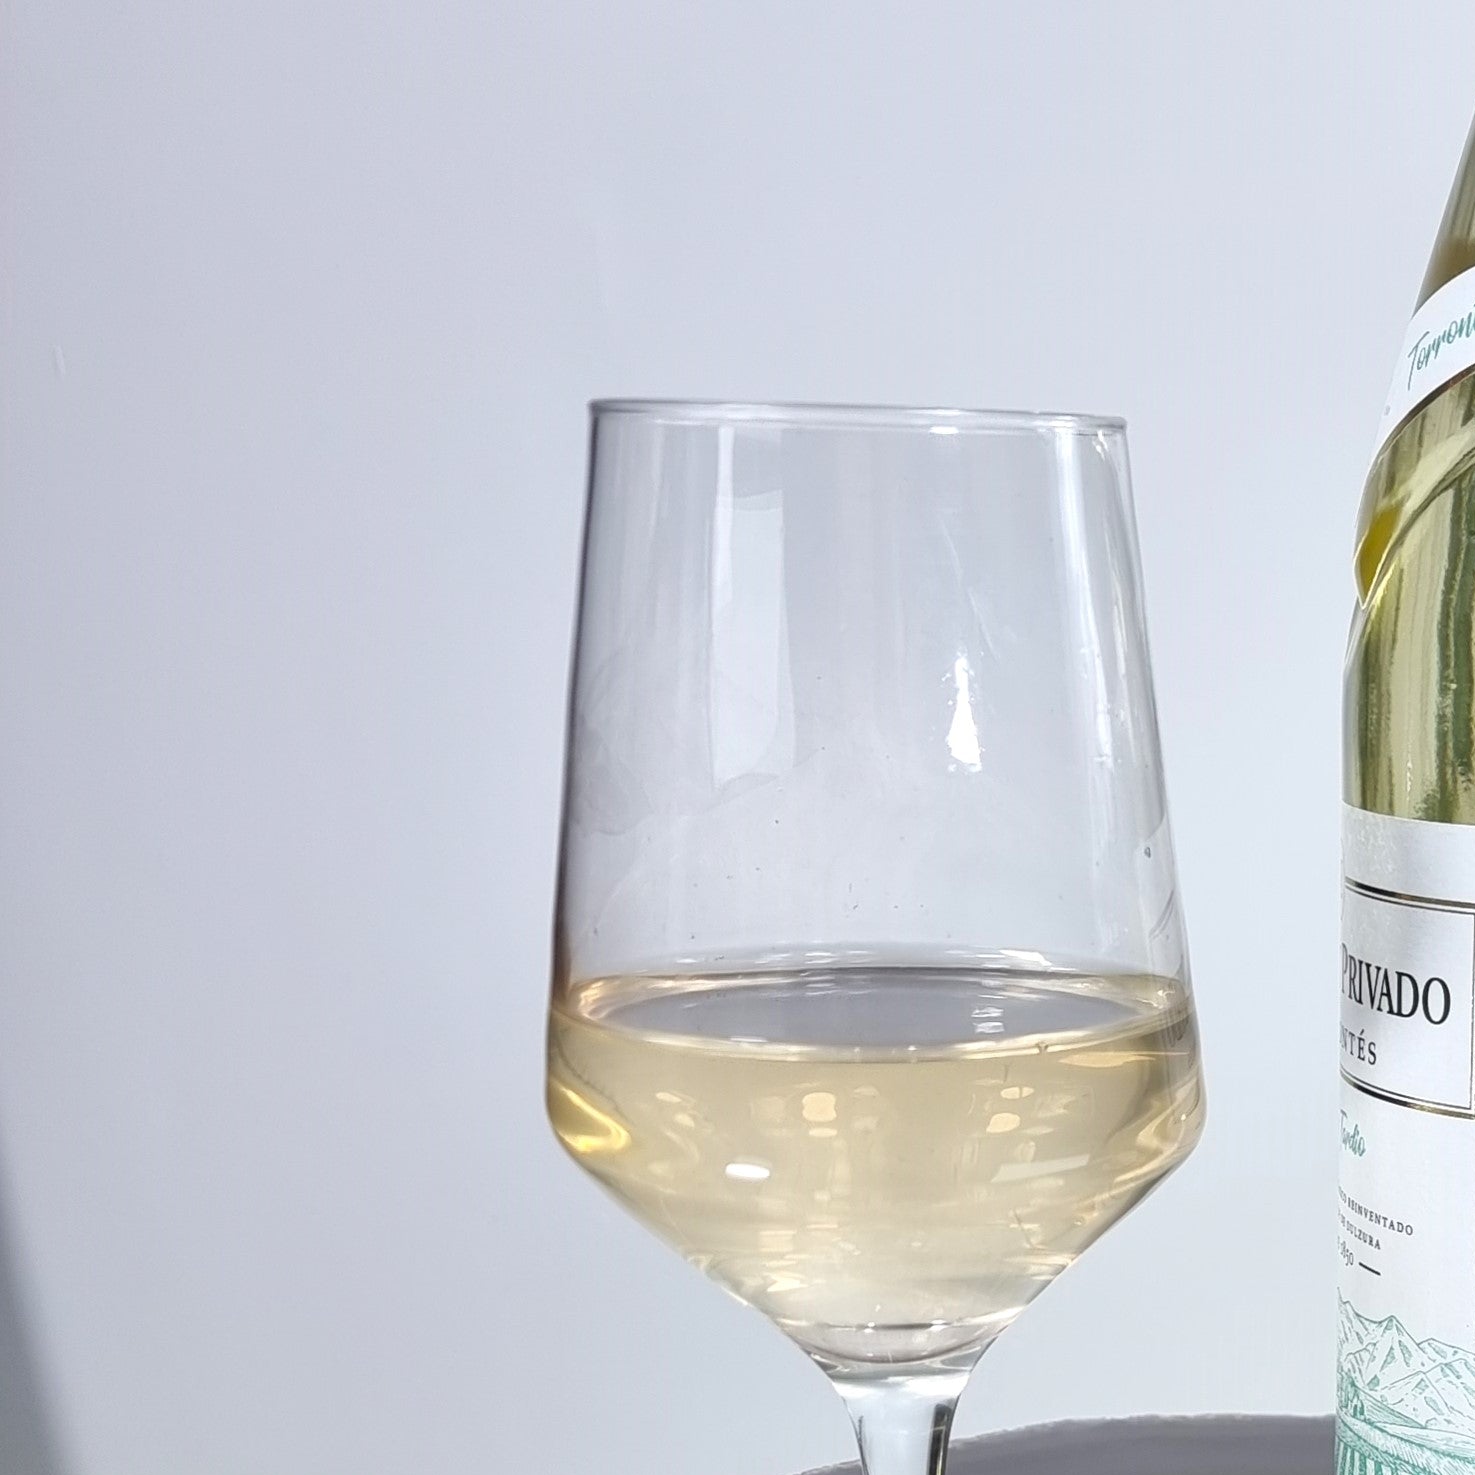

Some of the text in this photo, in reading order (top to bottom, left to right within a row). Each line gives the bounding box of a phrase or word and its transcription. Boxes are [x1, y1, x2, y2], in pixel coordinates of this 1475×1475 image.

[1341, 943, 1451, 1025] PRIVADO
[1346, 1219, 1381, 1250] DULZURA
[1347, 1196, 1414, 1236] REINVENTADO
